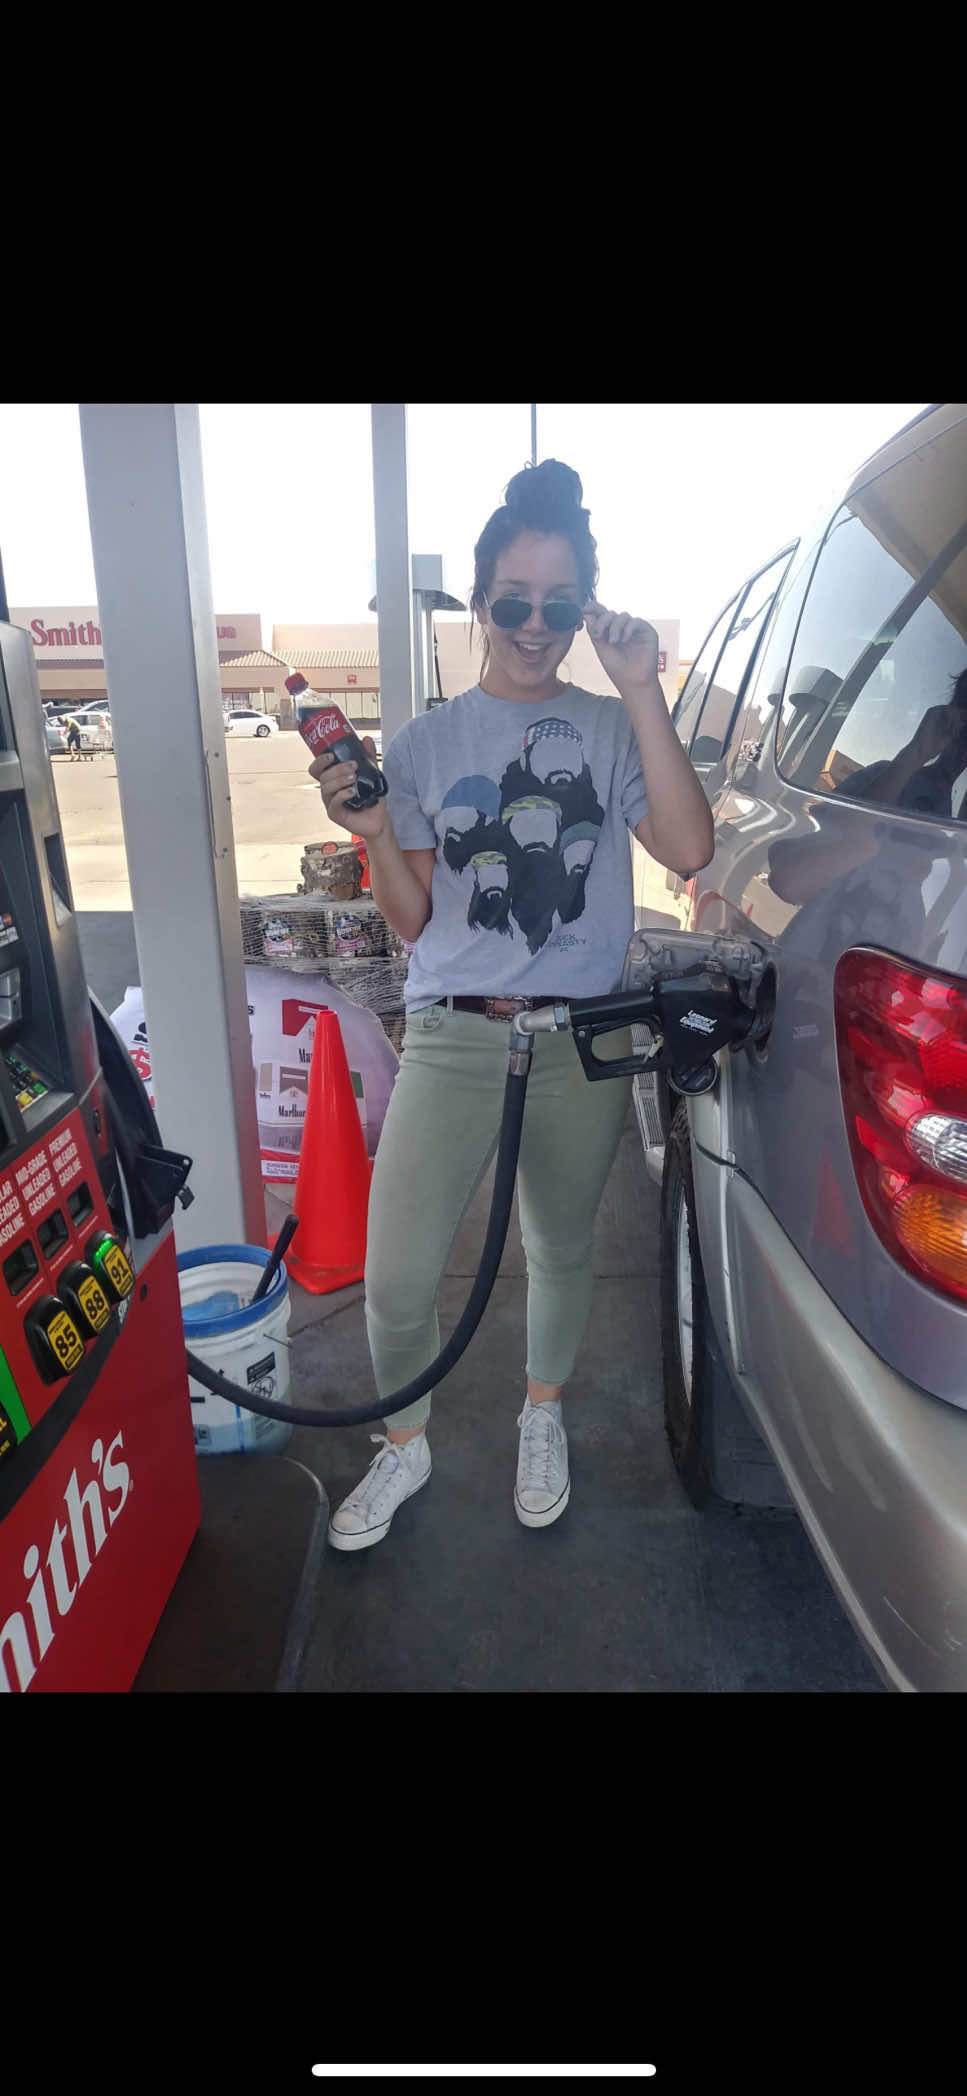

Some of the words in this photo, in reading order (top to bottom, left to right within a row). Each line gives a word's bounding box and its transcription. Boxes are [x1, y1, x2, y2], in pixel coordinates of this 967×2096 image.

[30, 619, 104, 647] Smith
[216, 625, 237, 640] UG
[278, 1104, 308, 1119] Marlbor
[22, 1167, 51, 1202] UNLEADED
[59, 1157, 82, 1187] GASOLINE
[28, 1182, 56, 1217] GASOLINE
[111, 1257, 129, 1286] 91
[85, 1289, 105, 1321] 88
[55, 1323, 77, 1360] 85
